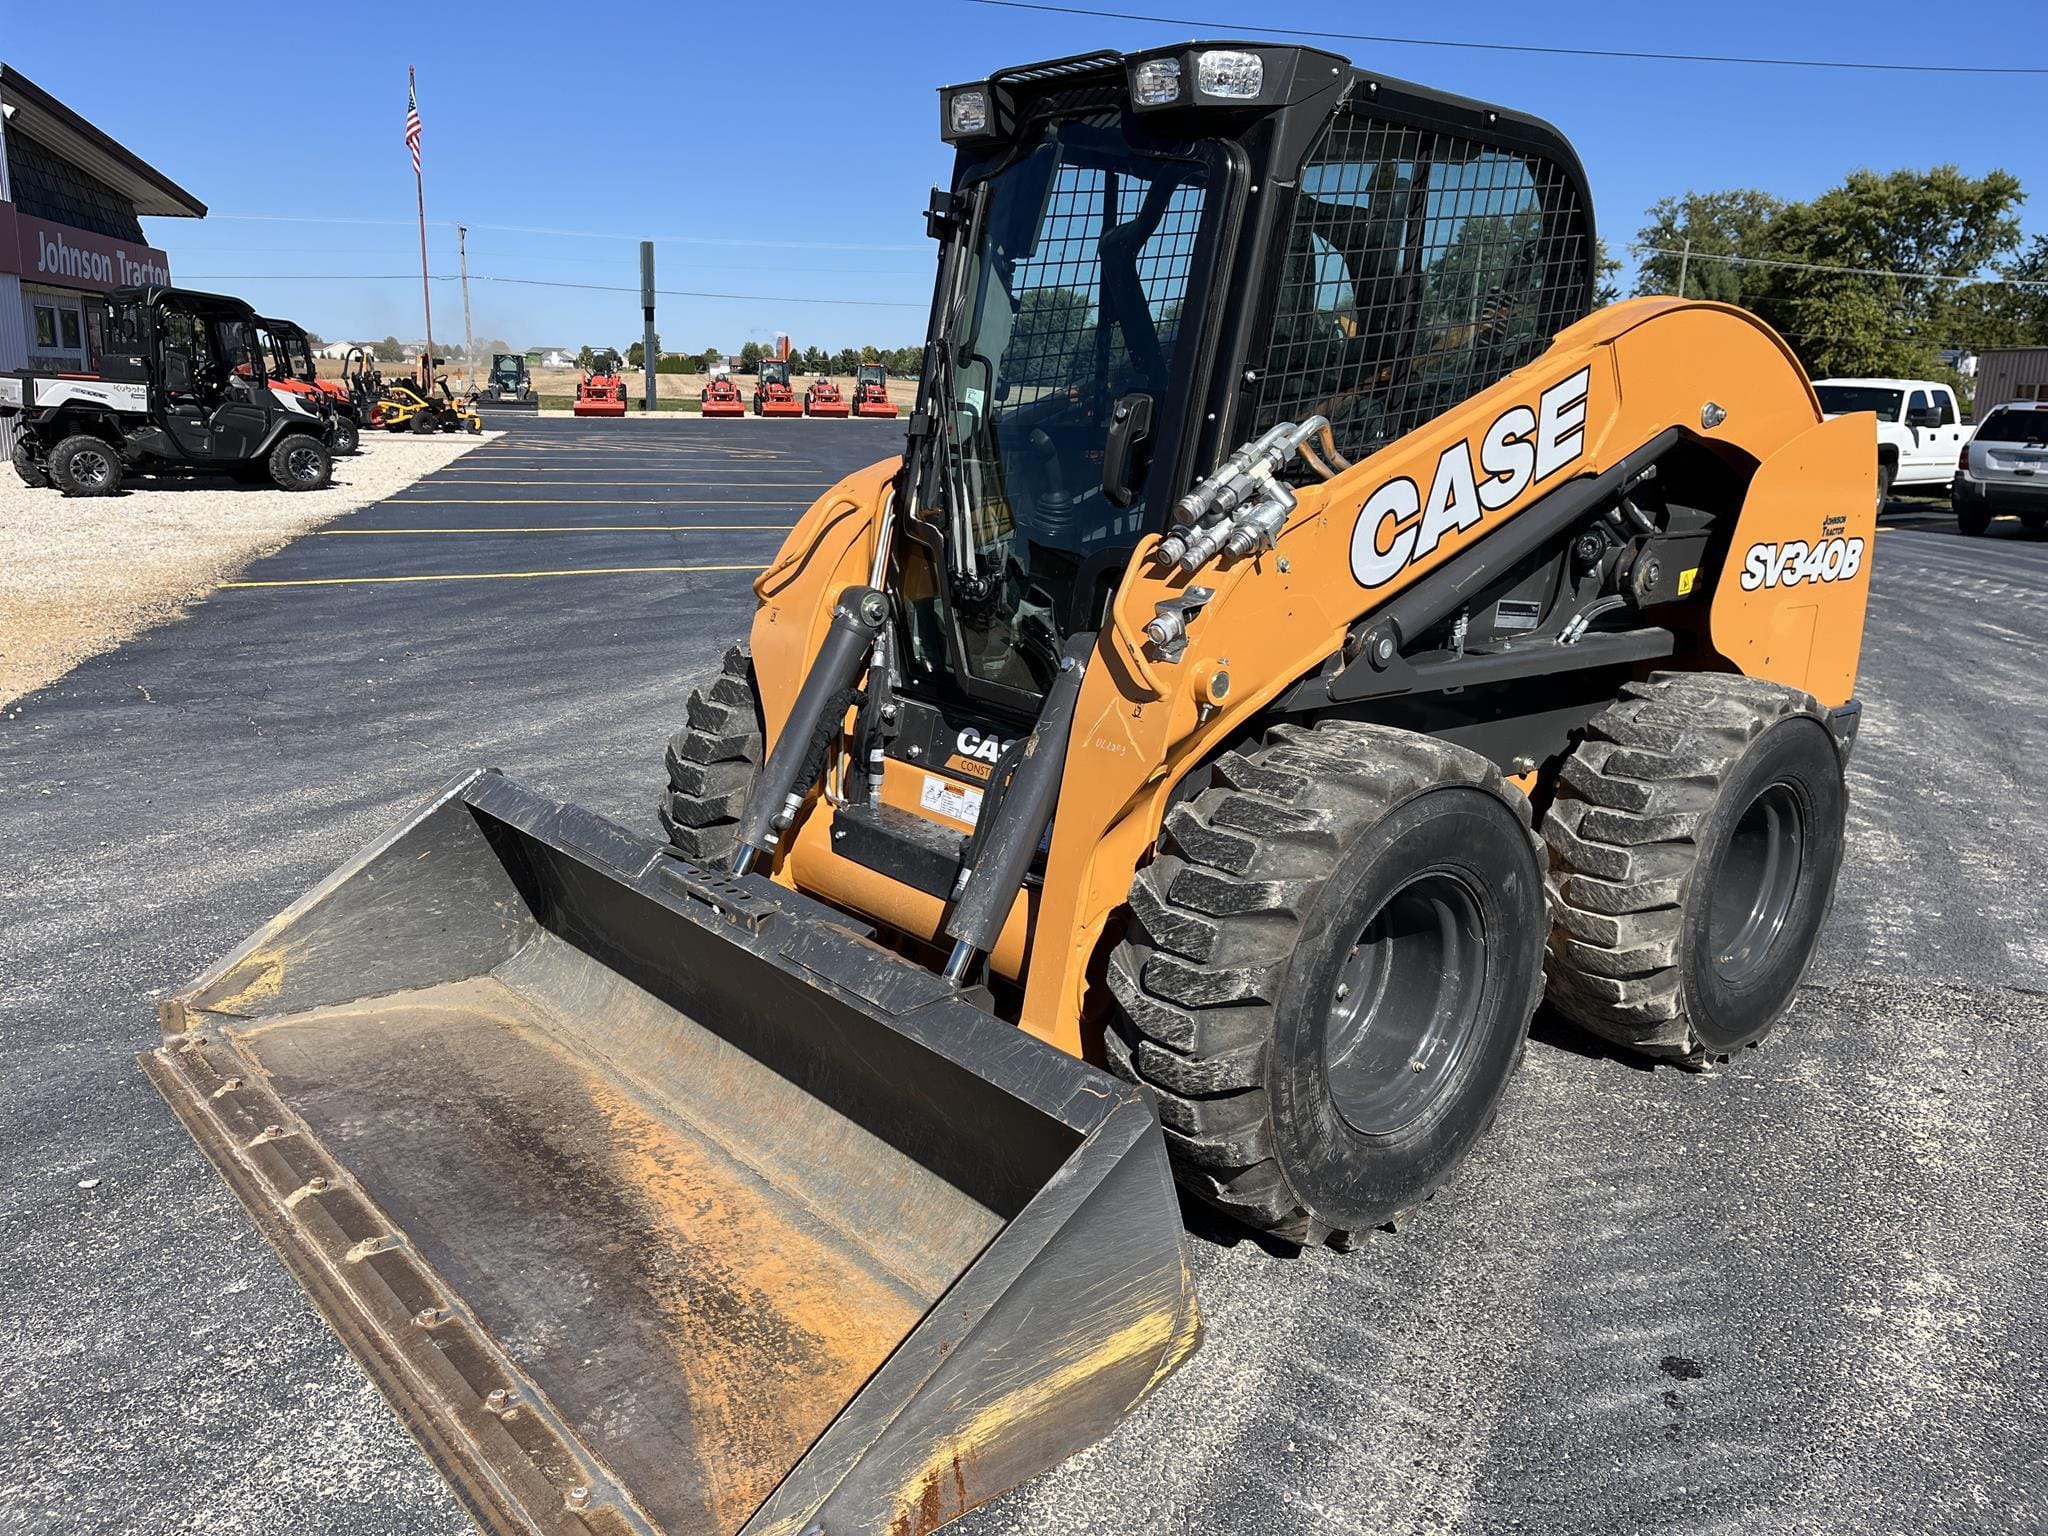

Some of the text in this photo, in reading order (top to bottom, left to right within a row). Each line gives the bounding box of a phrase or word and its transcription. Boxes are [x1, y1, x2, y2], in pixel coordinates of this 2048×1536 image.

[38, 231, 168, 287] Johnson Tractor
[1349, 364, 1591, 590] CASE
[1740, 537, 1865, 592] SV340B
